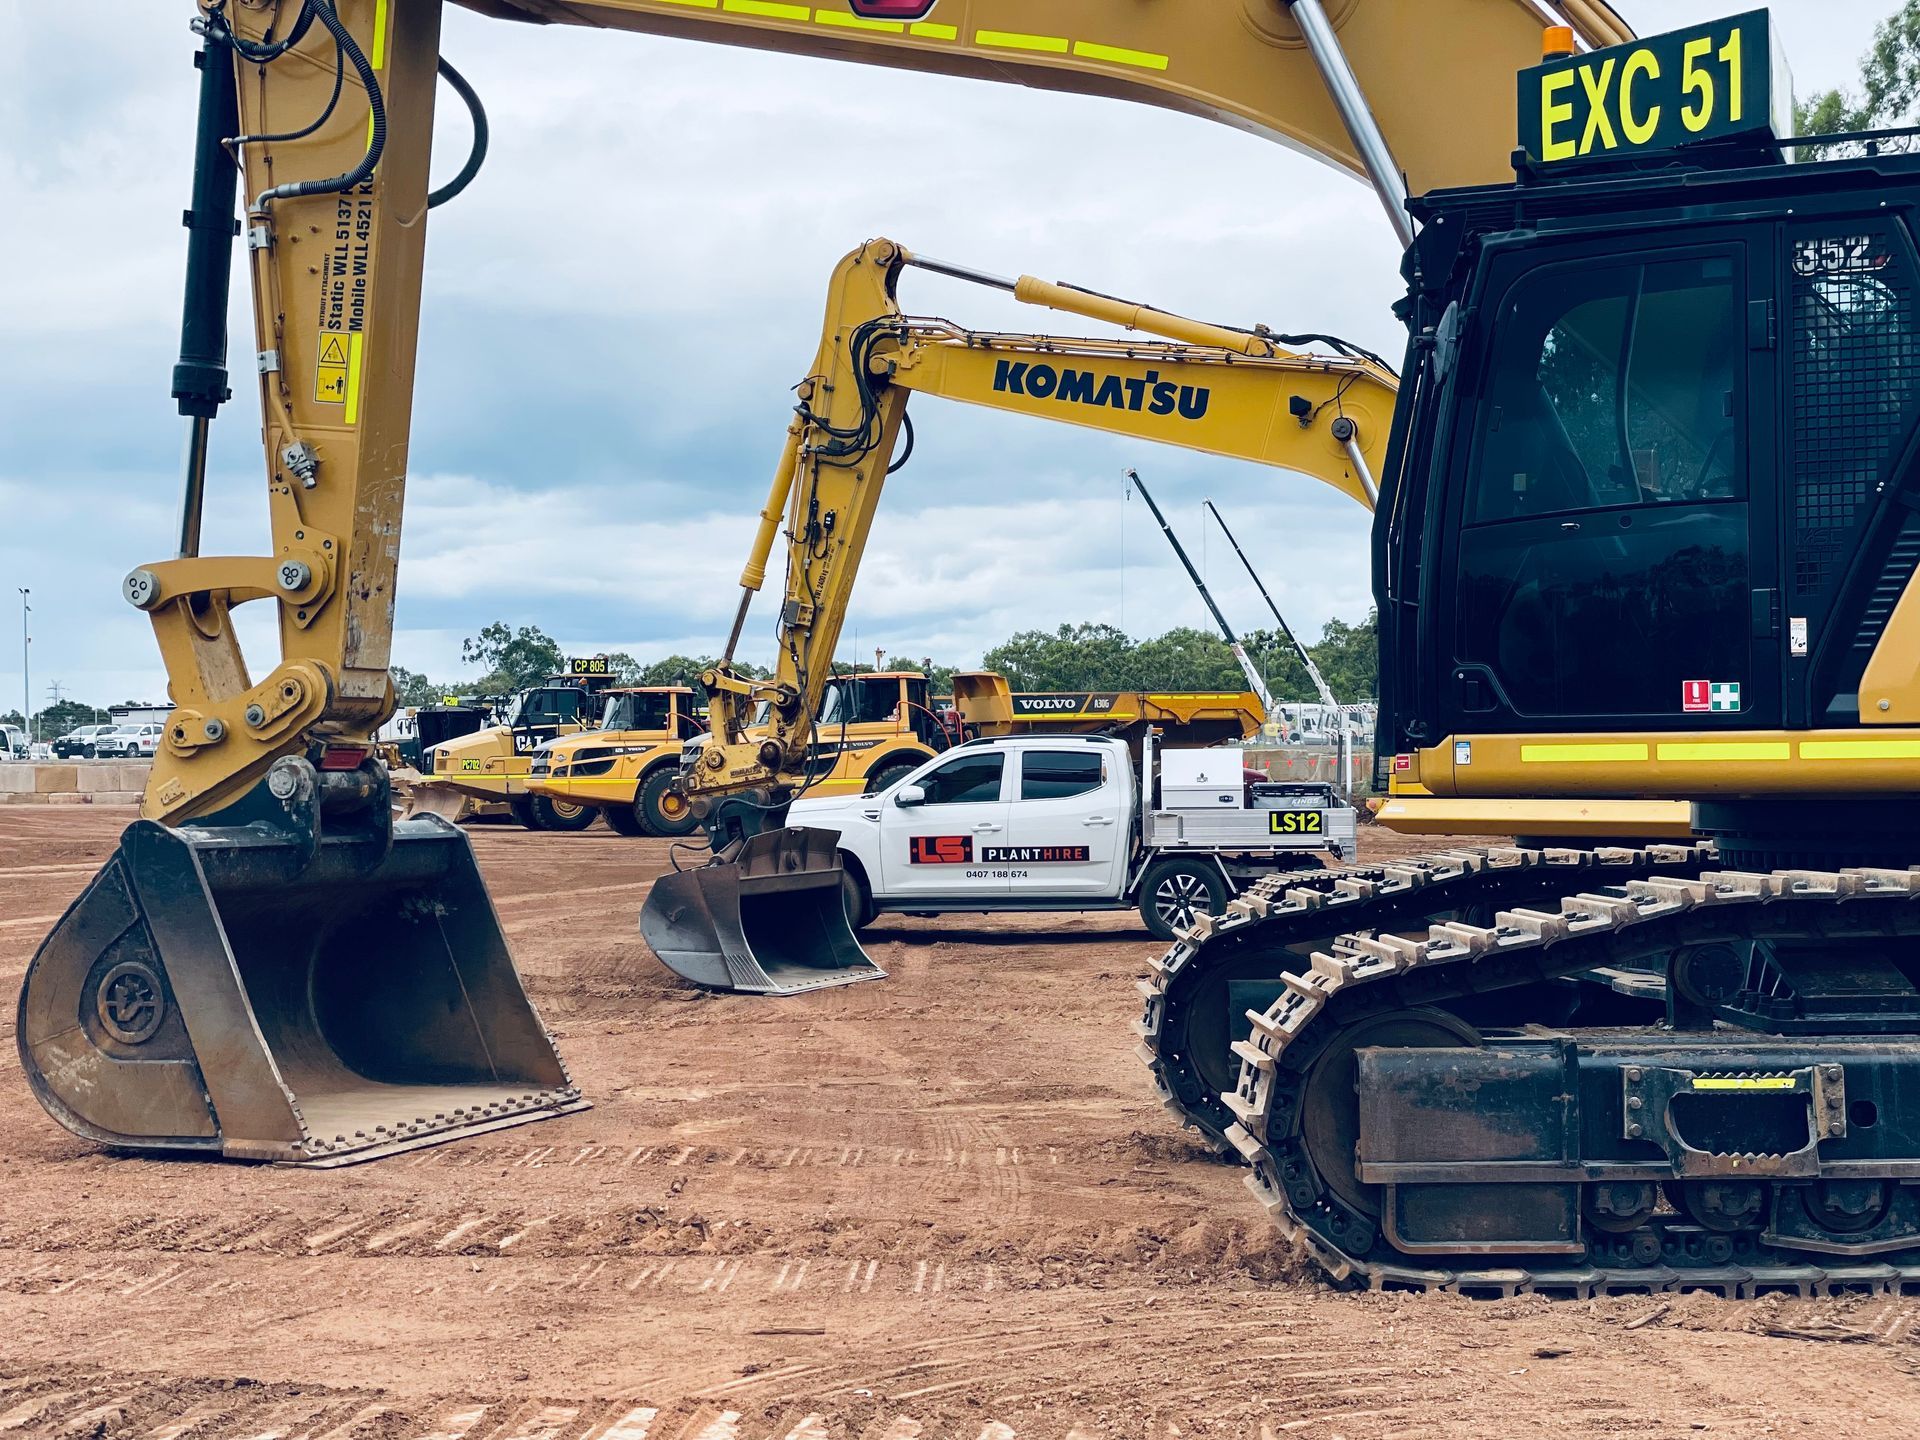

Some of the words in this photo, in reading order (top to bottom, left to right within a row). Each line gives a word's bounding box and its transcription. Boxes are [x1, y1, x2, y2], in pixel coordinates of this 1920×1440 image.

[1541, 48, 1661, 162] EXC
[1680, 27, 1742, 132] 51
[336, 199, 352, 240] 5137
[356, 201, 372, 241] 4521
[332, 243, 349, 276] WLL
[353, 243, 369, 276] WLL
[1795, 235, 1870, 271] 352
[322, 253, 330, 296] ATTACHMENT
[319, 298, 327, 327] WITHOUT
[328, 281, 345, 330] Static
[349, 278, 366, 331] Mobile
[992, 359, 1211, 420] KOMATSU
[574, 659, 588, 672] CP
[589, 660, 605, 673] 805
[1019, 699, 1076, 710] VOLVO
[1093, 698, 1110, 709] A30G
[515, 734, 544, 752] CAT
[462, 759, 480, 770] PC702
[1271, 812, 1320, 832] LS12
[917, 837, 965, 863] LS
[966, 870, 989, 878] 0407
[992, 870, 1009, 878] 188
[1011, 870, 1028, 878] 674
